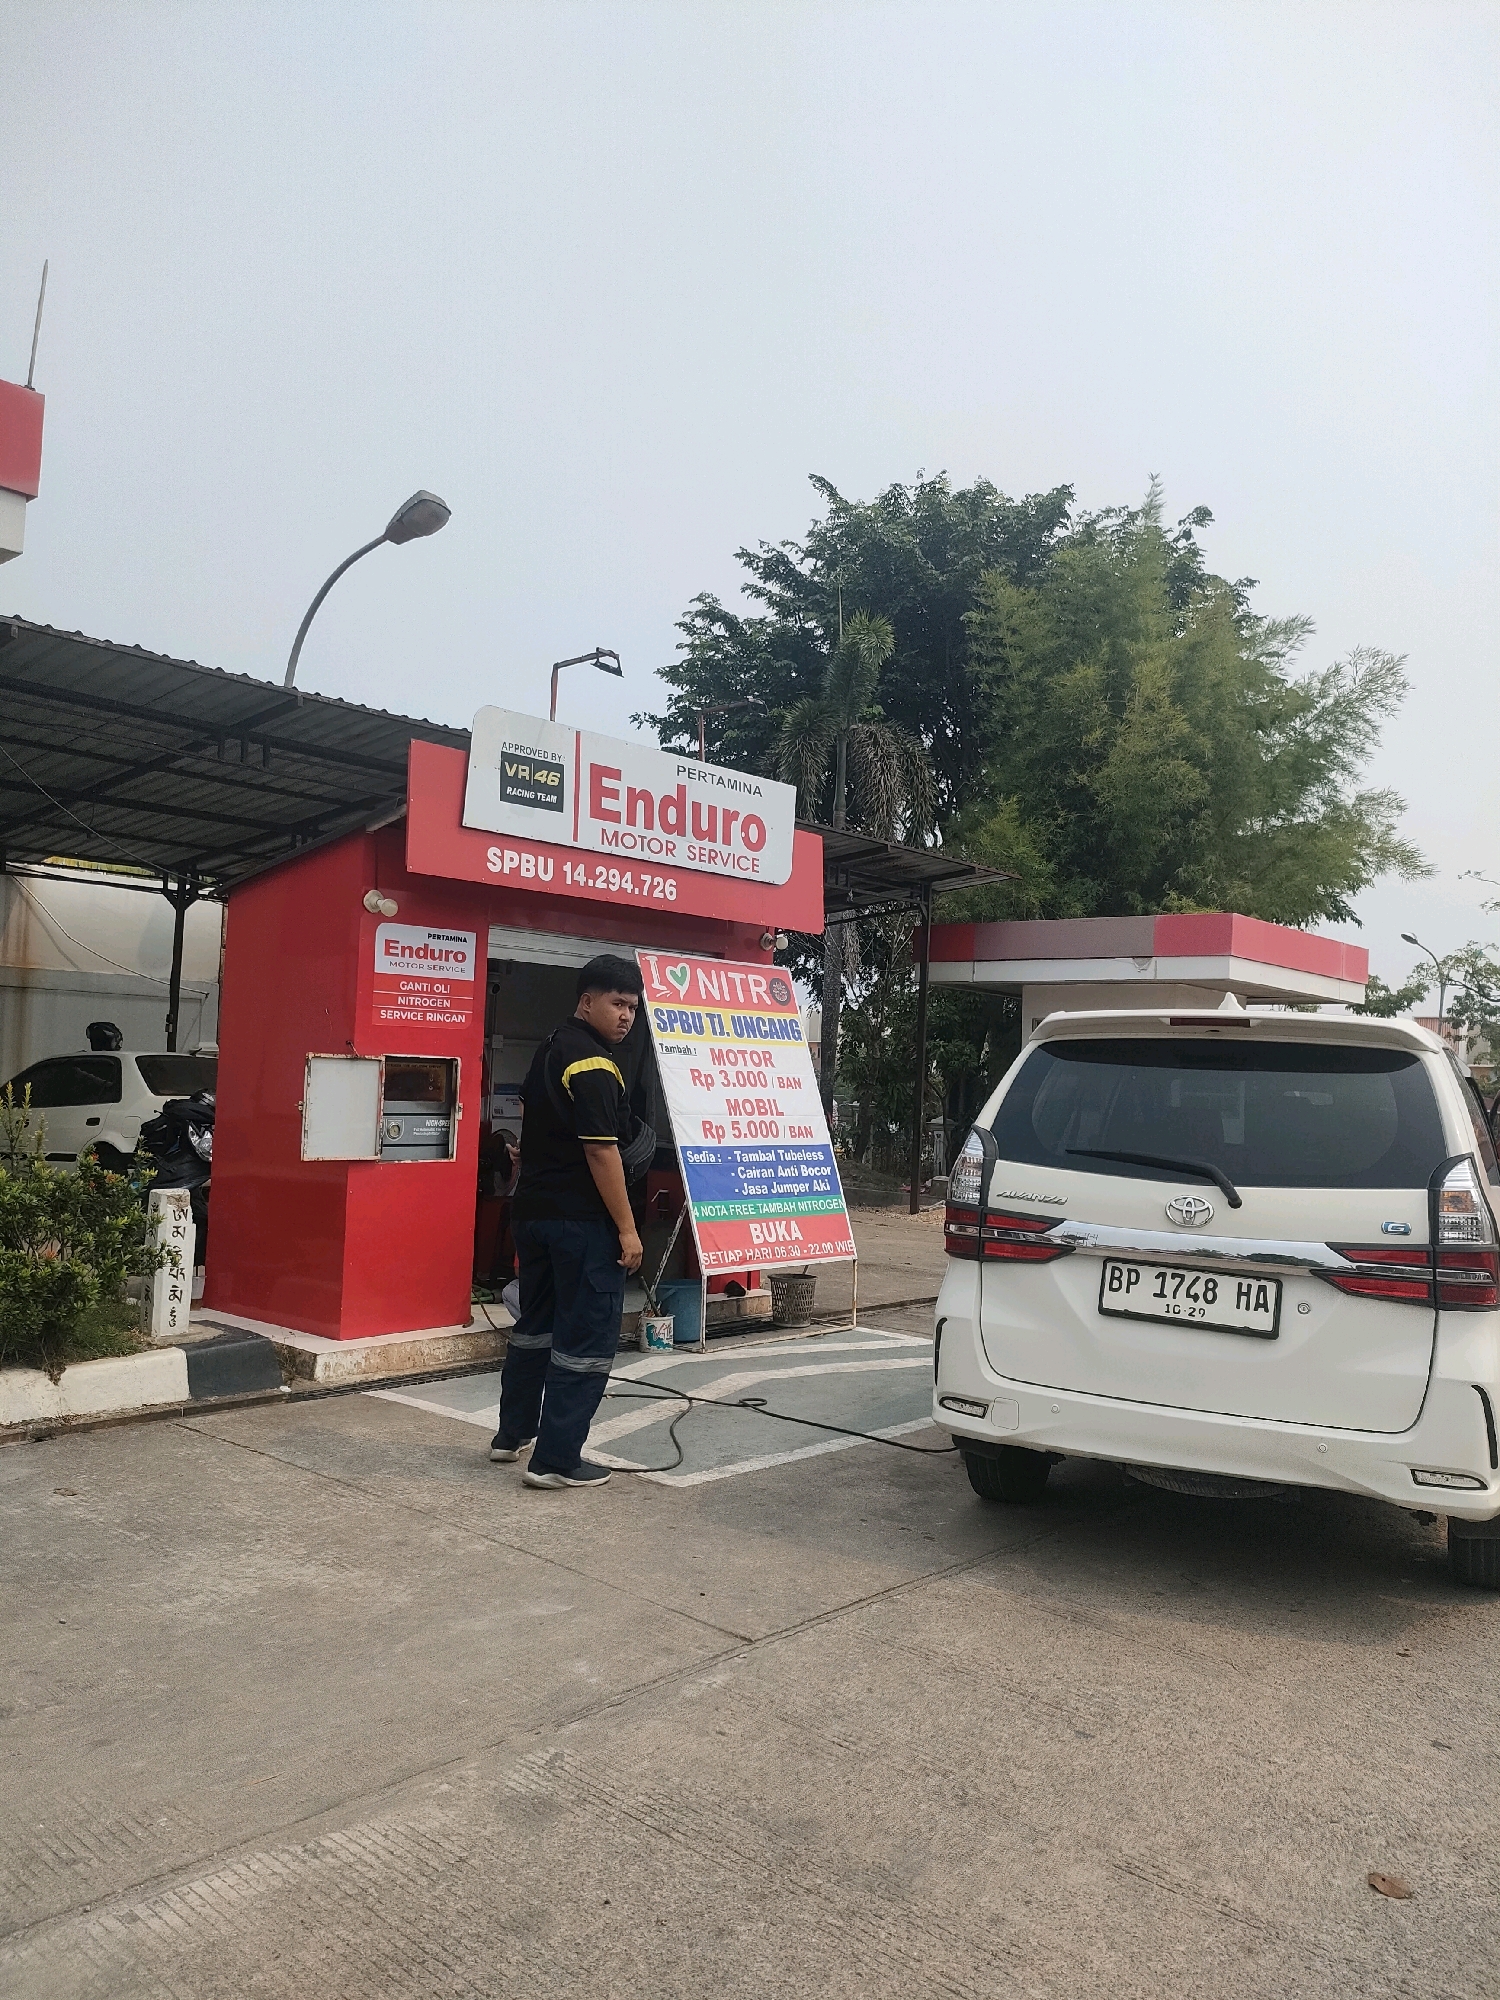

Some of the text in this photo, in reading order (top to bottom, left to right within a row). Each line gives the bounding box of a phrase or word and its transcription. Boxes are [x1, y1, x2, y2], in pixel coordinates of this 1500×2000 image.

[501, 741, 549, 759] APPROVED
[676, 764, 763, 798] PERTAMINA
[506, 786, 557, 804] RACING TEAM
[589, 762, 767, 853] Enduro
[601, 827, 760, 874] MOTOR SERVICE
[486, 846, 677, 901] SPBU 14.294.726
[427, 932, 468, 944] PERTAMINA
[384, 938, 467, 964] Enduro
[389, 960, 466, 974] MOTOR SERVICE
[399, 981, 450, 994] GANTI OLI
[397, 996, 451, 1008] NITROGEN
[380, 1009, 466, 1023] SERVICE RINGAN
[653, 1007, 705, 1036] SPBU
[730, 1014, 803, 1042] UNCANG
[709, 1047, 776, 1069] MOTOR
[689, 1068, 716, 1091] Rp
[718, 1069, 769, 1088] 3.000
[776, 1076, 803, 1090] BAN
[725, 1098, 785, 1117] MOBIL
[701, 1120, 726, 1145] Rp
[731, 1120, 780, 1139] 5.000
[788, 1125, 814, 1139] BAN
[733, 1150, 776, 1163] Tambal
[777, 1149, 825, 1162] Tubeless
[737, 1166, 775, 1179] Cairan
[777, 1165, 799, 1178] Anti
[800, 1164, 832, 1177] Bocor
[741, 1182, 768, 1196] Jasa
[770, 1180, 810, 1196] Jumper
[813, 1178, 831, 1192] Aki
[700, 1204, 729, 1217] NOTA
[729, 1203, 757, 1216] FREE
[756, 1201, 797, 1214] TAMBAH
[797, 1198, 846, 1212] NITROGEN
[996, 1190, 1069, 1206] AVANZA
[749, 1220, 804, 1245] BUKA
[701, 1249, 743, 1266] SETIAP
[744, 1246, 773, 1261] HARI
[774, 1244, 801, 1260] 06.30
[808, 1241, 834, 1255] 22.00
[835, 1239, 855, 1253] WIB
[1108, 1265, 1269, 1313] BP 1748 HA
